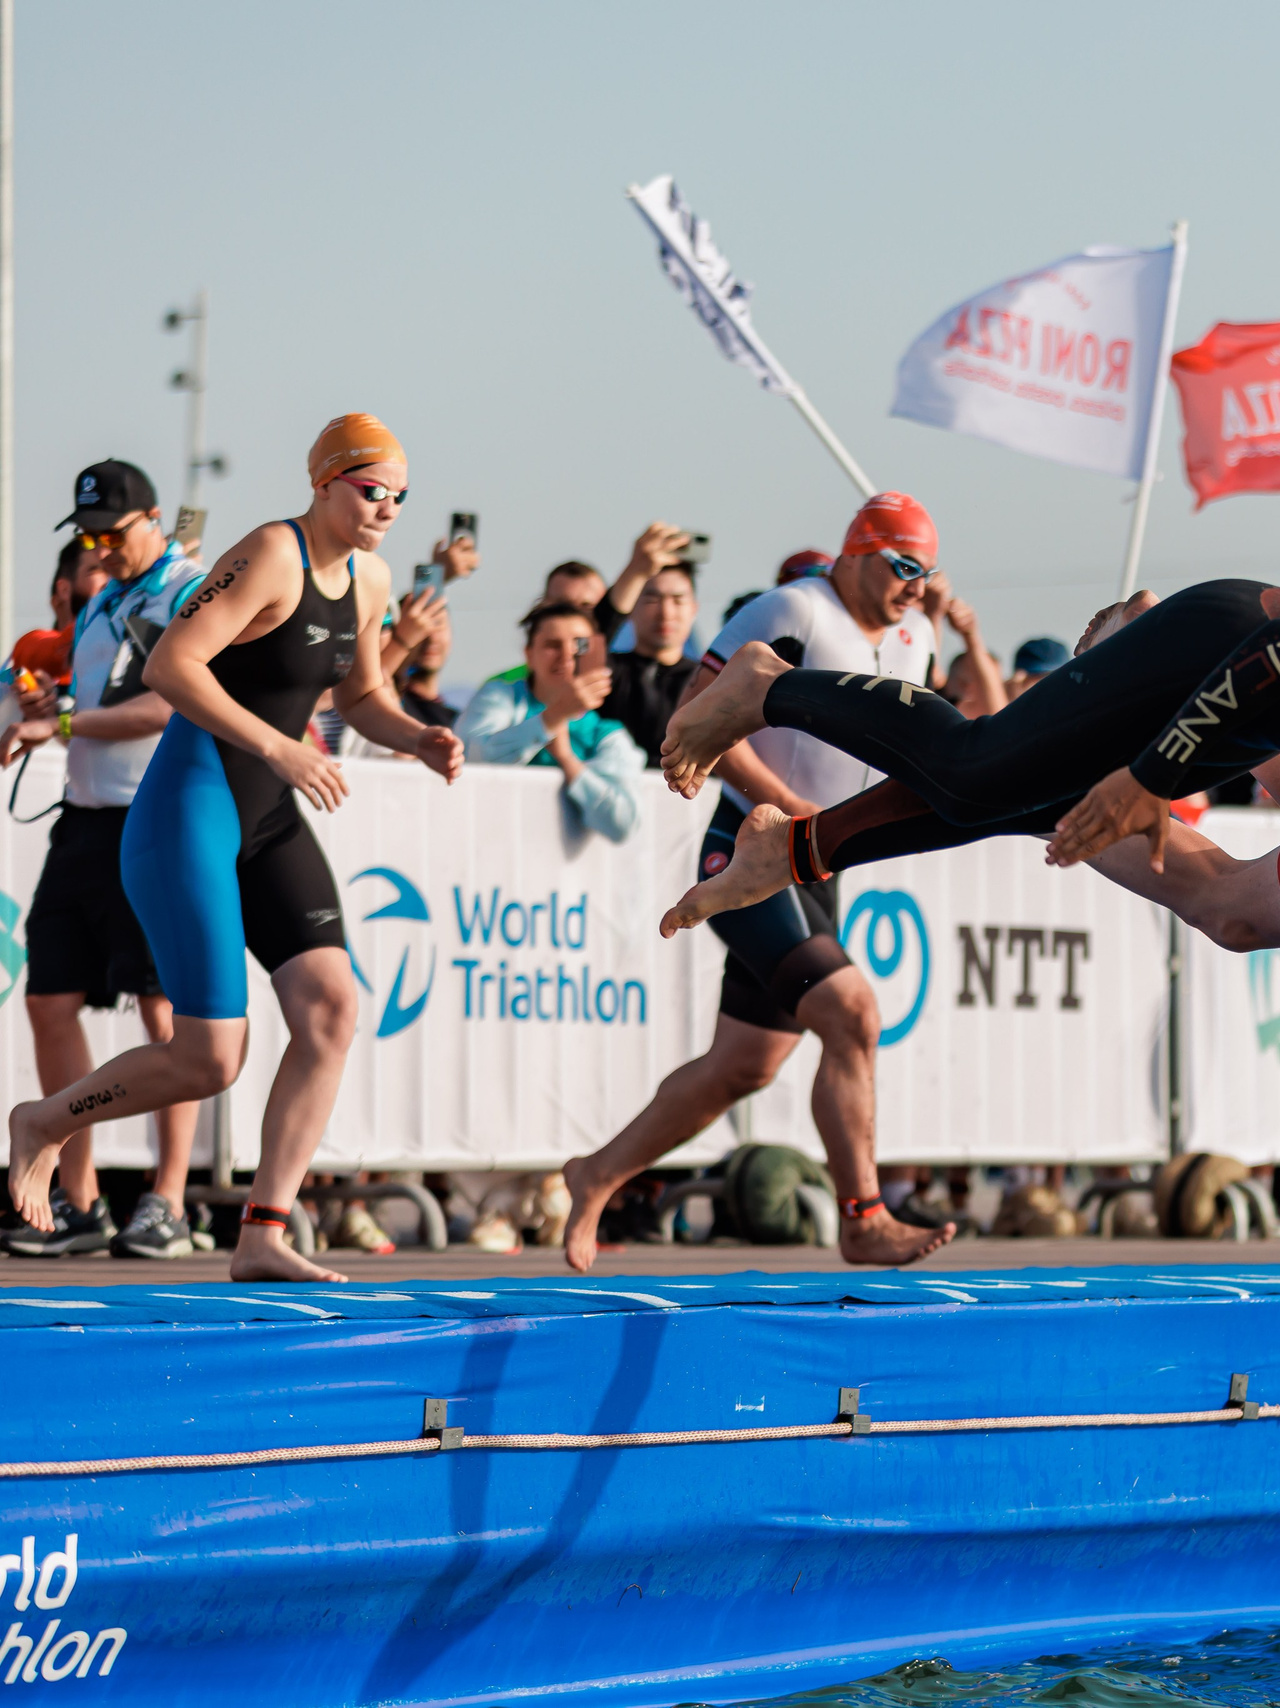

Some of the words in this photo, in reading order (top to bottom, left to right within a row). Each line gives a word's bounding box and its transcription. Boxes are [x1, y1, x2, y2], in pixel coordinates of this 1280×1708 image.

[180, 571, 236, 619] 353
[453, 885, 587, 949] World
[451, 959, 647, 1025] Triathlon
[957, 925, 1090, 1010] NTT
[69, 1089, 113, 1116] 353
[0, 1619, 128, 1684] hlon
